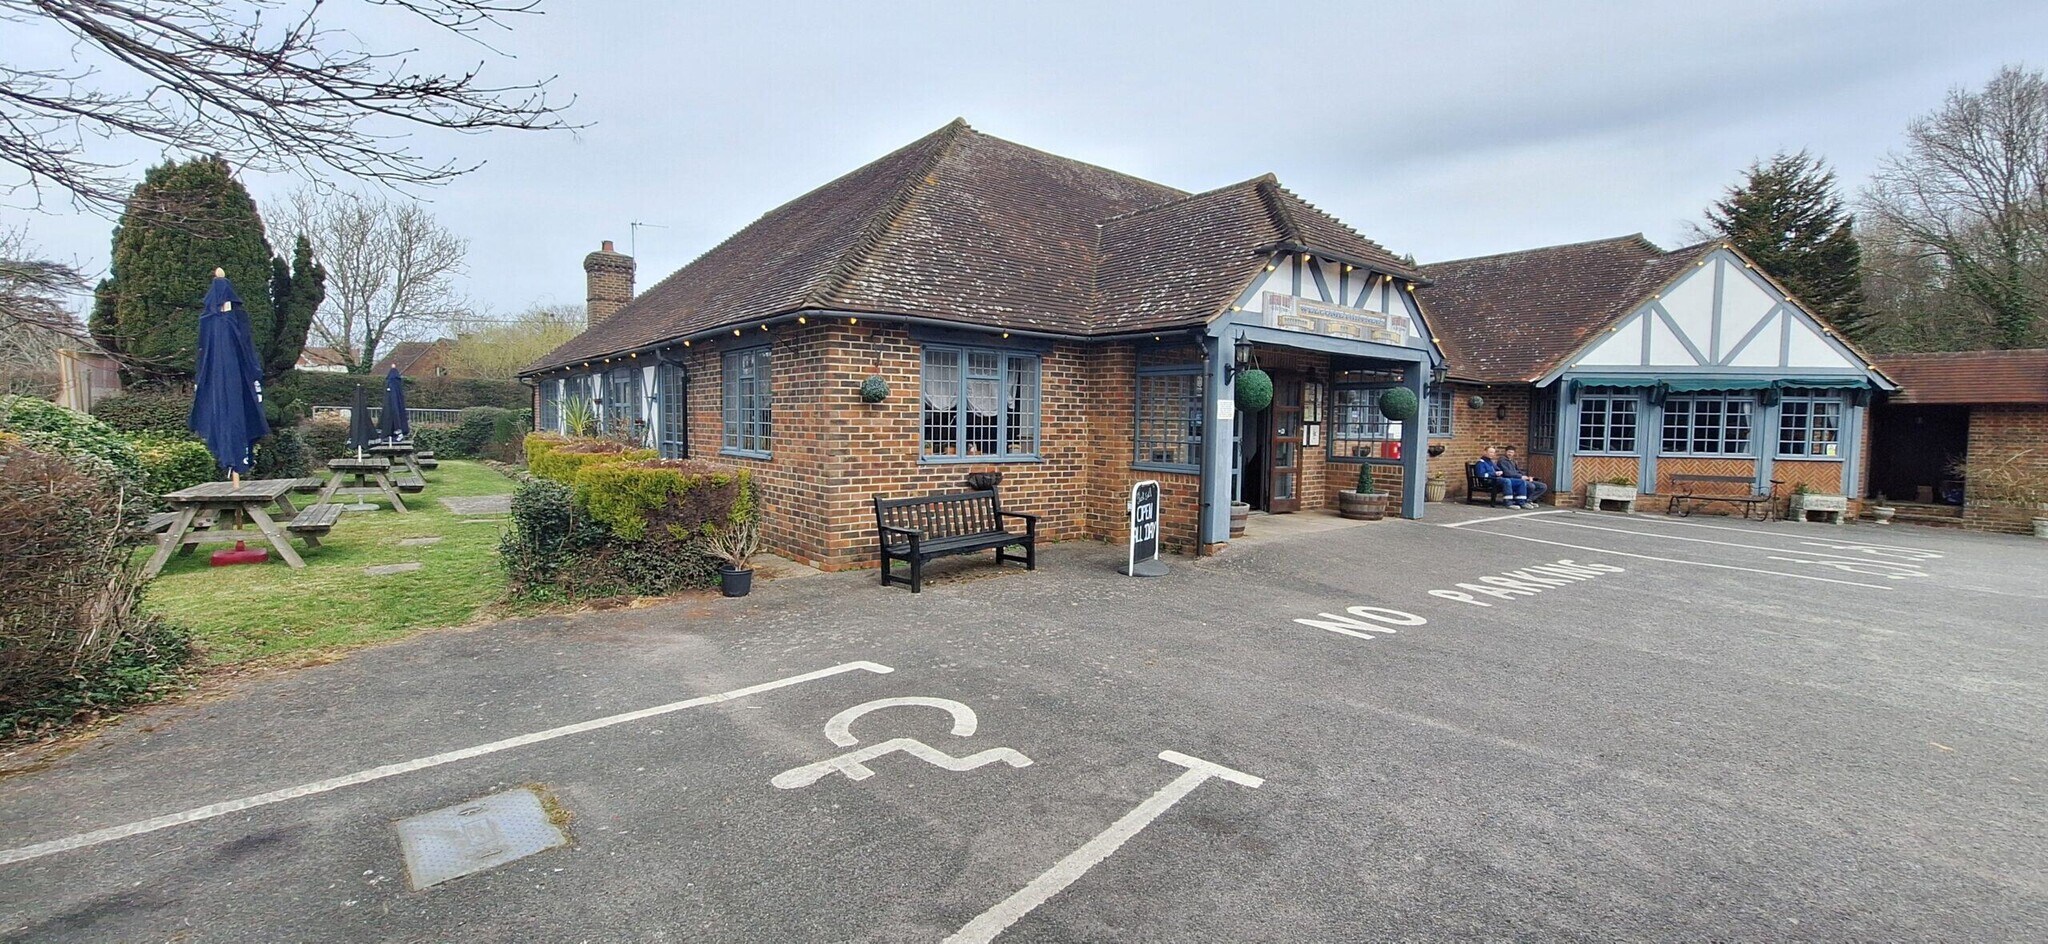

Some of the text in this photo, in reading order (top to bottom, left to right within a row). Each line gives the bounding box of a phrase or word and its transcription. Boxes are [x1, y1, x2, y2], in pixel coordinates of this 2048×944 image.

[1137, 503, 1153, 522] OPEN
[1134, 521, 1157, 543] ALL DAY
[1293, 559, 1626, 640] NO PARKING
